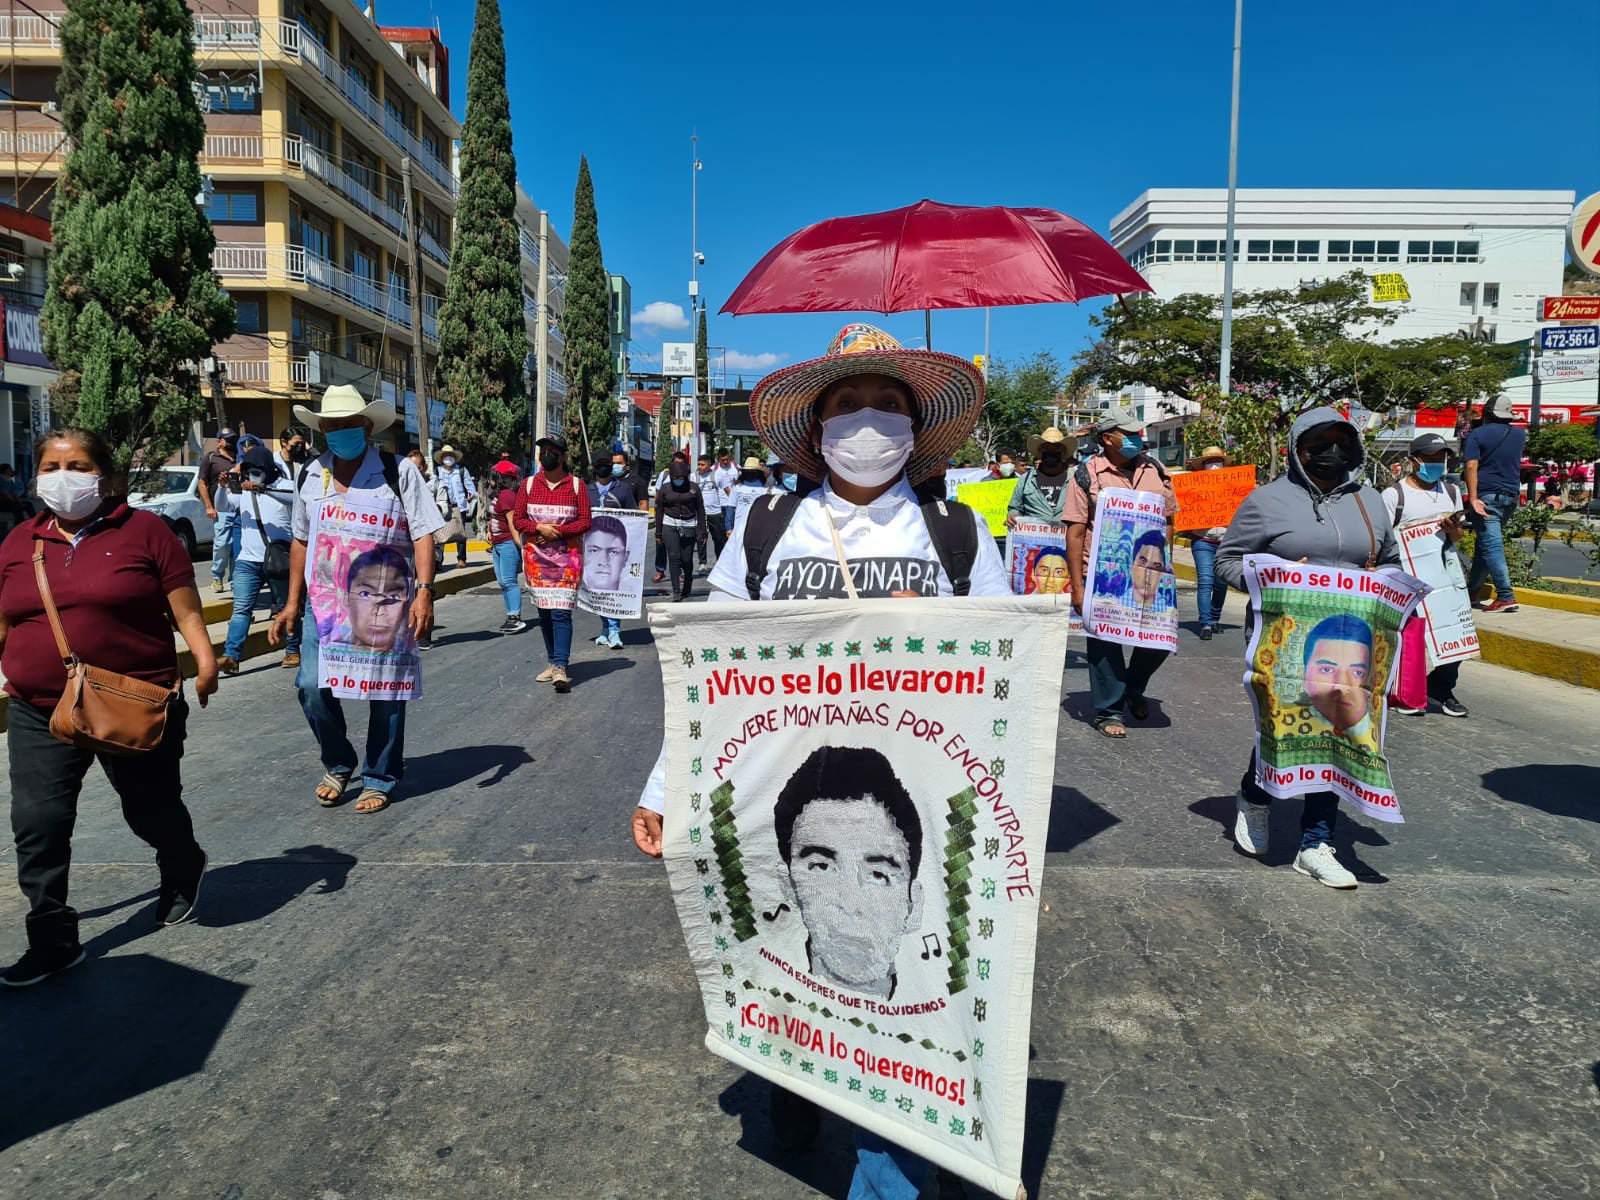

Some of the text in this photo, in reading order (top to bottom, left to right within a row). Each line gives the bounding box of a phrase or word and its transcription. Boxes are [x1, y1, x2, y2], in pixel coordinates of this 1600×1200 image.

[1545, 333, 1595, 348] 472-5614
[1106, 496, 1134, 509] ¡Vivo
[1138, 503, 1151, 512] se
[321, 505, 357, 522] ¡Vivo
[361, 513, 378, 525] se
[382, 513, 394, 528] lo
[1014, 522, 1036, 533] ¡Vivo
[1039, 524, 1048, 533] se
[1050, 525, 1058, 534] lo
[1405, 526, 1433, 542] ¡Vivo
[777, 560, 937, 594] AYOTZINAPA
[1259, 567, 1414, 608] ¡Vivo se lo llevaron!
[1094, 623, 1121, 635] ¡Vivo
[1124, 627, 1135, 637] lo
[1440, 639, 1460, 654] ¡Con
[343, 675, 355, 688] lo
[705, 662, 985, 704] ¡Vivo se lo llevaron!
[1301, 740, 1358, 760] CABALLERO
[1264, 766, 1294, 785] ¡Vivo
[1299, 767, 1315, 780] lo
[712, 700, 1034, 901] MOVERE MONTAÑAS POR ENCONTRARTE
[759, 947, 947, 1017] NUNCA ESPERES QUE TE OLVIDEMOS
[741, 1003, 967, 1106] ¡Con VIDA lo queremos!
